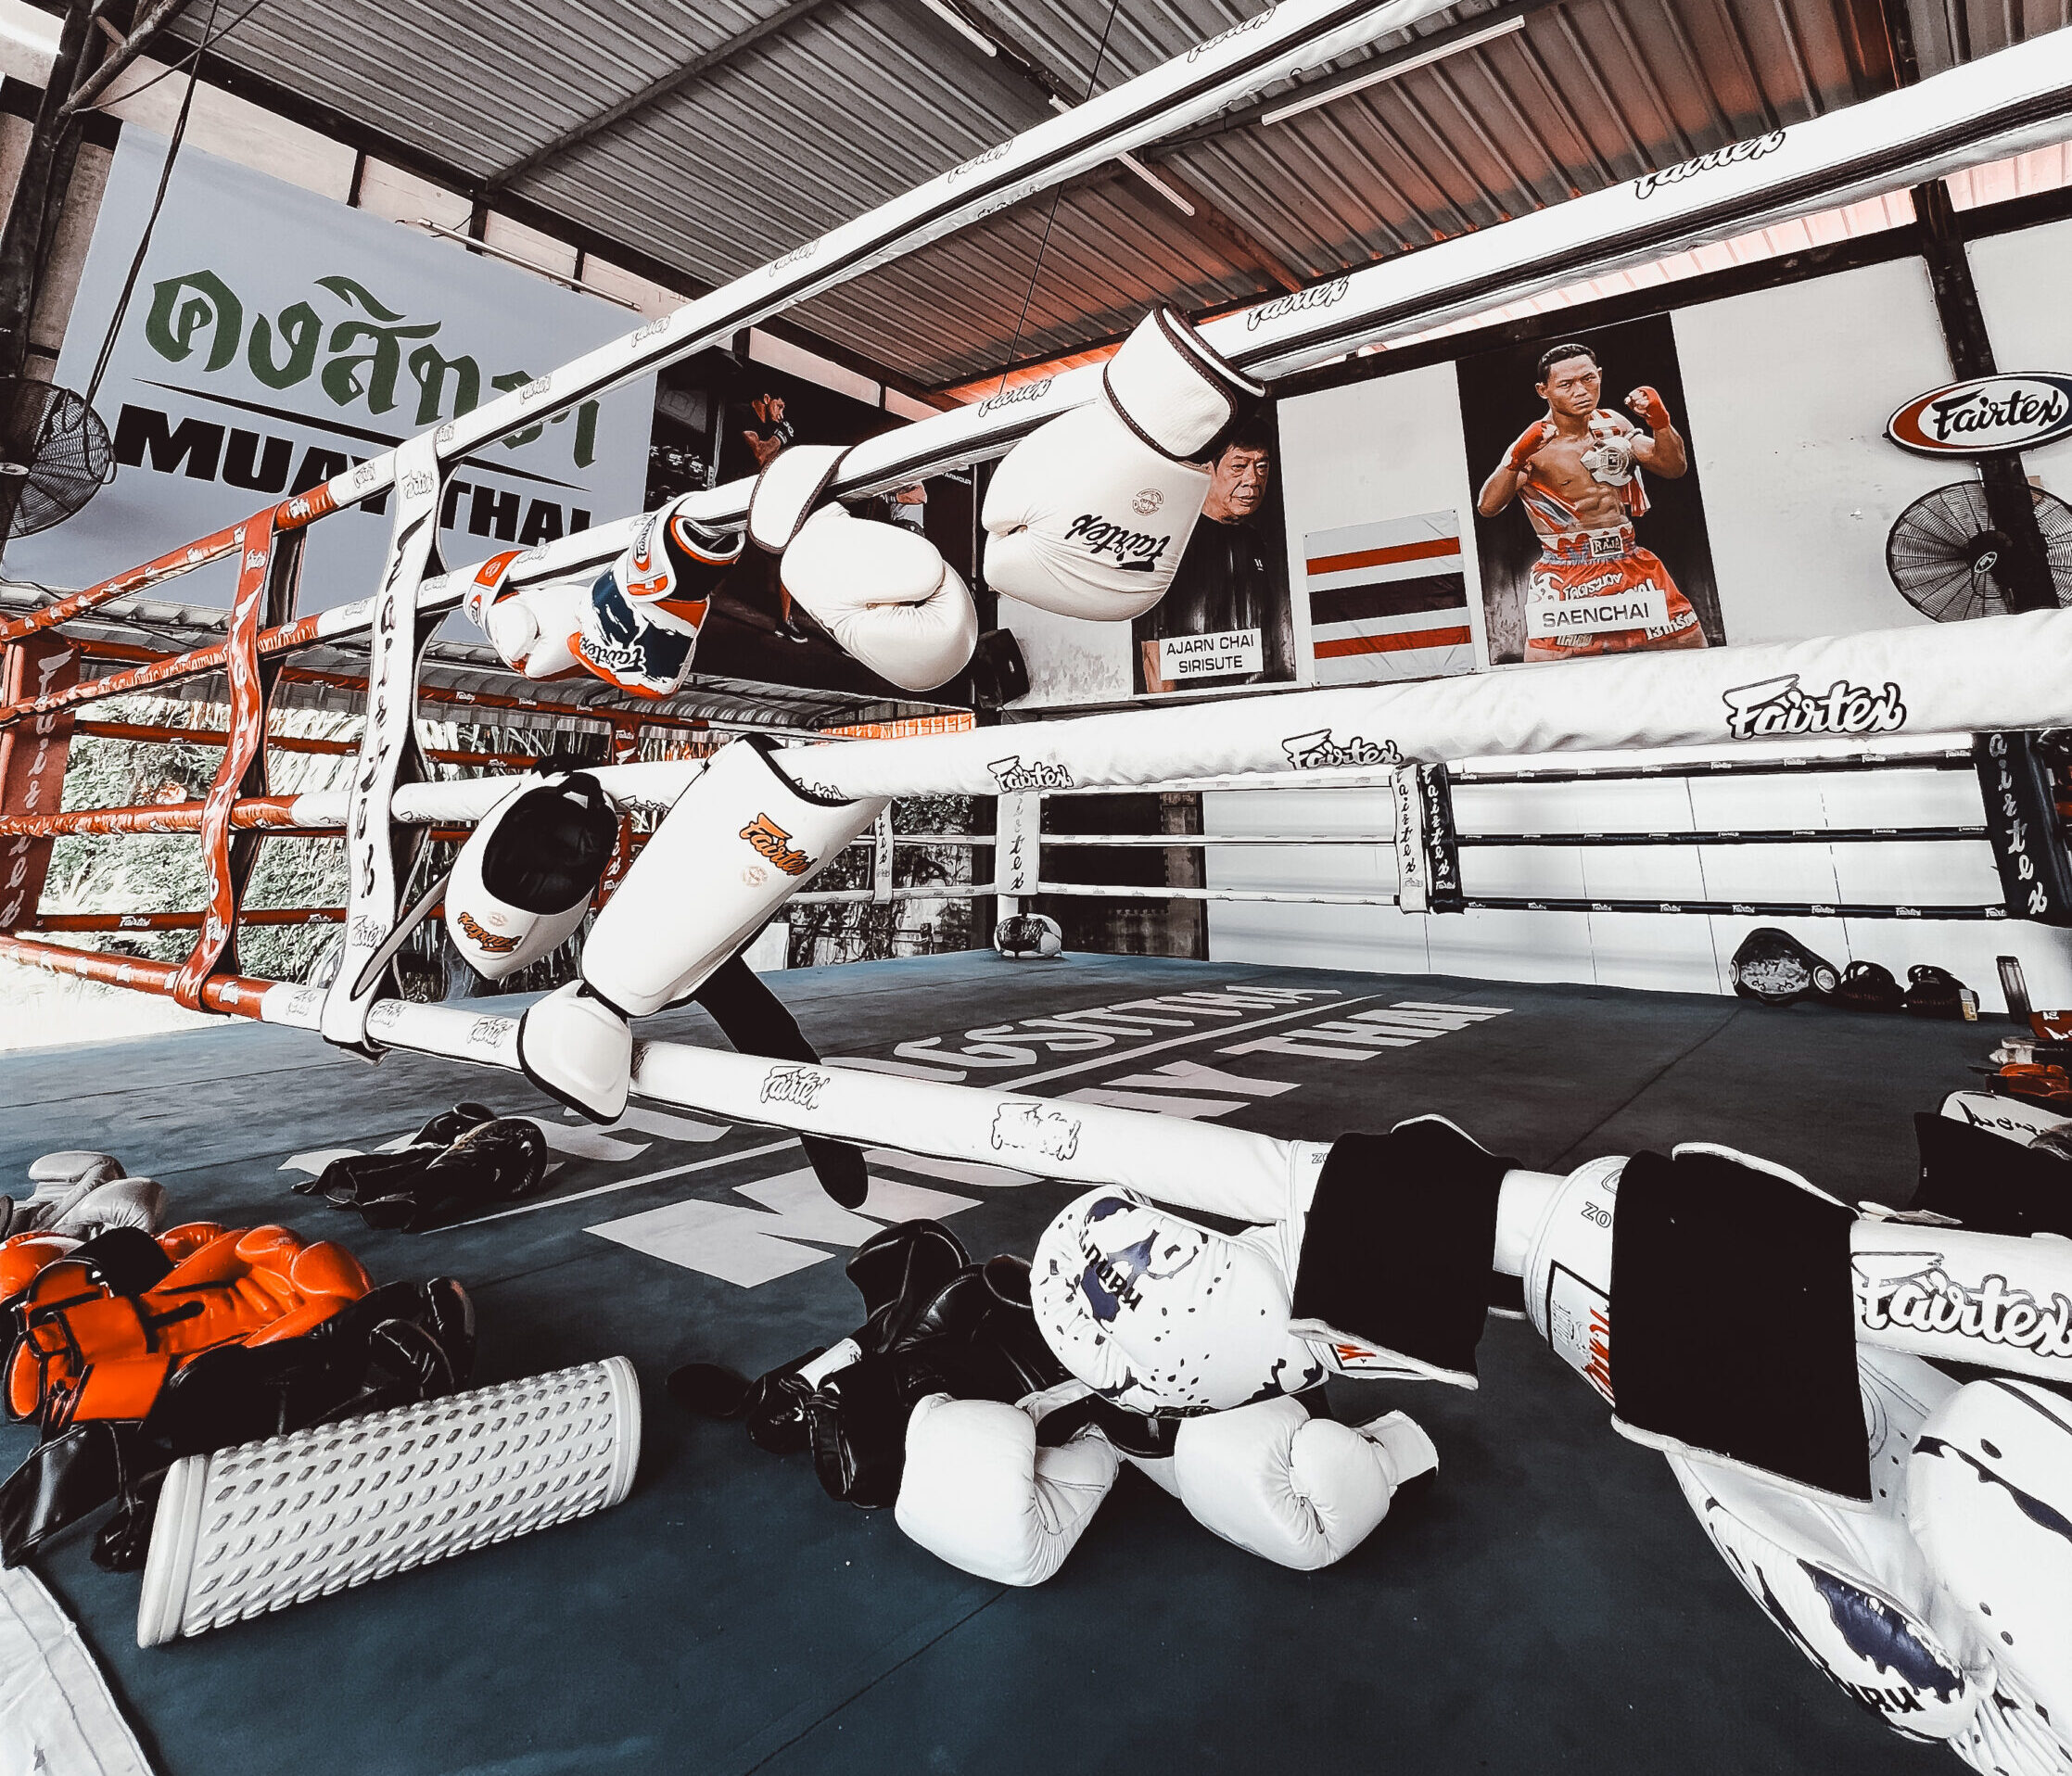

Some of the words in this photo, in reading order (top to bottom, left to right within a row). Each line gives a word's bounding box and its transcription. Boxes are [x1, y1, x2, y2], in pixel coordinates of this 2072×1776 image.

[1931, 387, 2063, 441] Fairtex
[1063, 514, 1172, 573] Fairtex
[1542, 602, 1650, 628] SAENCHAI
[1166, 637, 1215, 656] AJARN
[1219, 633, 1255, 651] CHAI
[1178, 654, 1244, 674] SIRISUTE
[1722, 674, 1907, 740] Fairtex
[986, 755, 1074, 793] Fairtex
[1281, 728, 1405, 770] Fairtex
[1989, 733, 2048, 915] airtex
[1214, 1001, 1514, 1061] THAI
[1850, 1250, 2072, 1358] Fairtex
